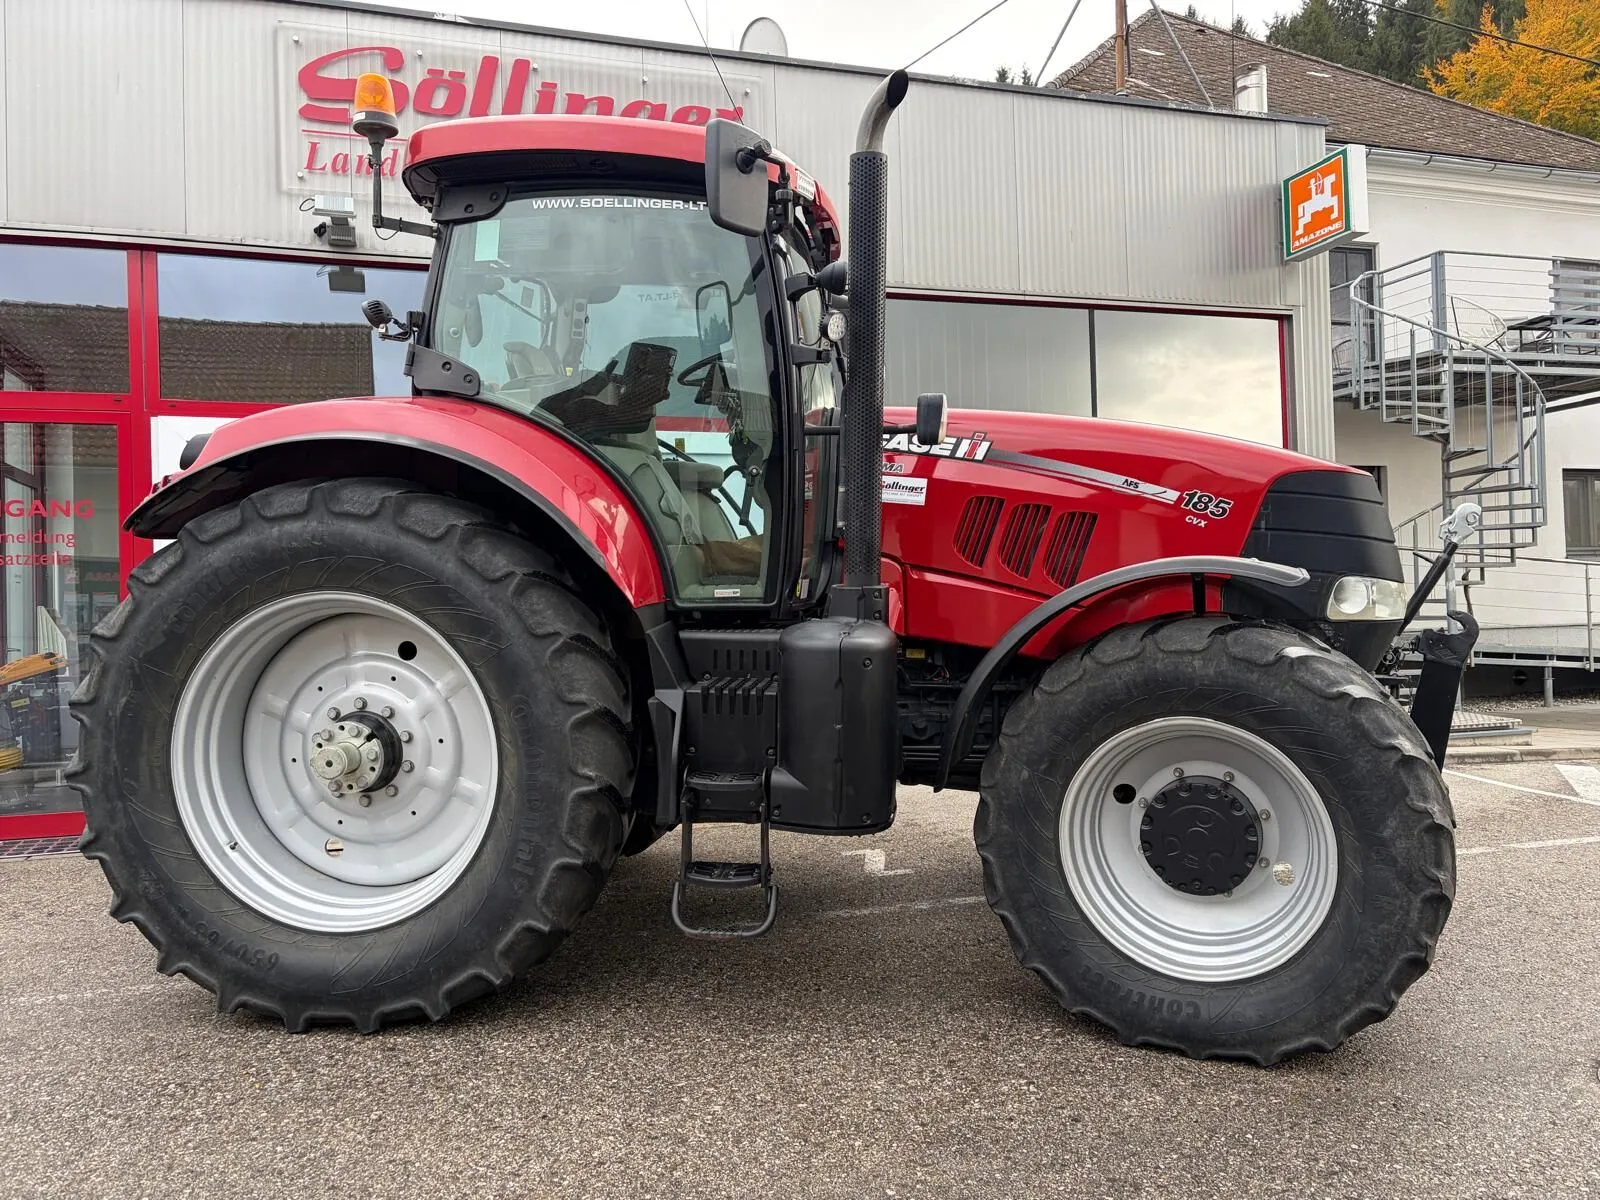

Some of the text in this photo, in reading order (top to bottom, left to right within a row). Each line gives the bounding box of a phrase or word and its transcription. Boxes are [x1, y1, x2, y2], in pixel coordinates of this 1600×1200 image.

[304, 141, 399, 177] Land
[1292, 221, 1343, 248] AMAZONE
[1122, 478, 1140, 489] AFS
[0, 499, 95, 519] GANG
[1181, 489, 1234, 519] 185
[1185, 515, 1208, 528] CVX
[0, 528, 75, 547] meldung
